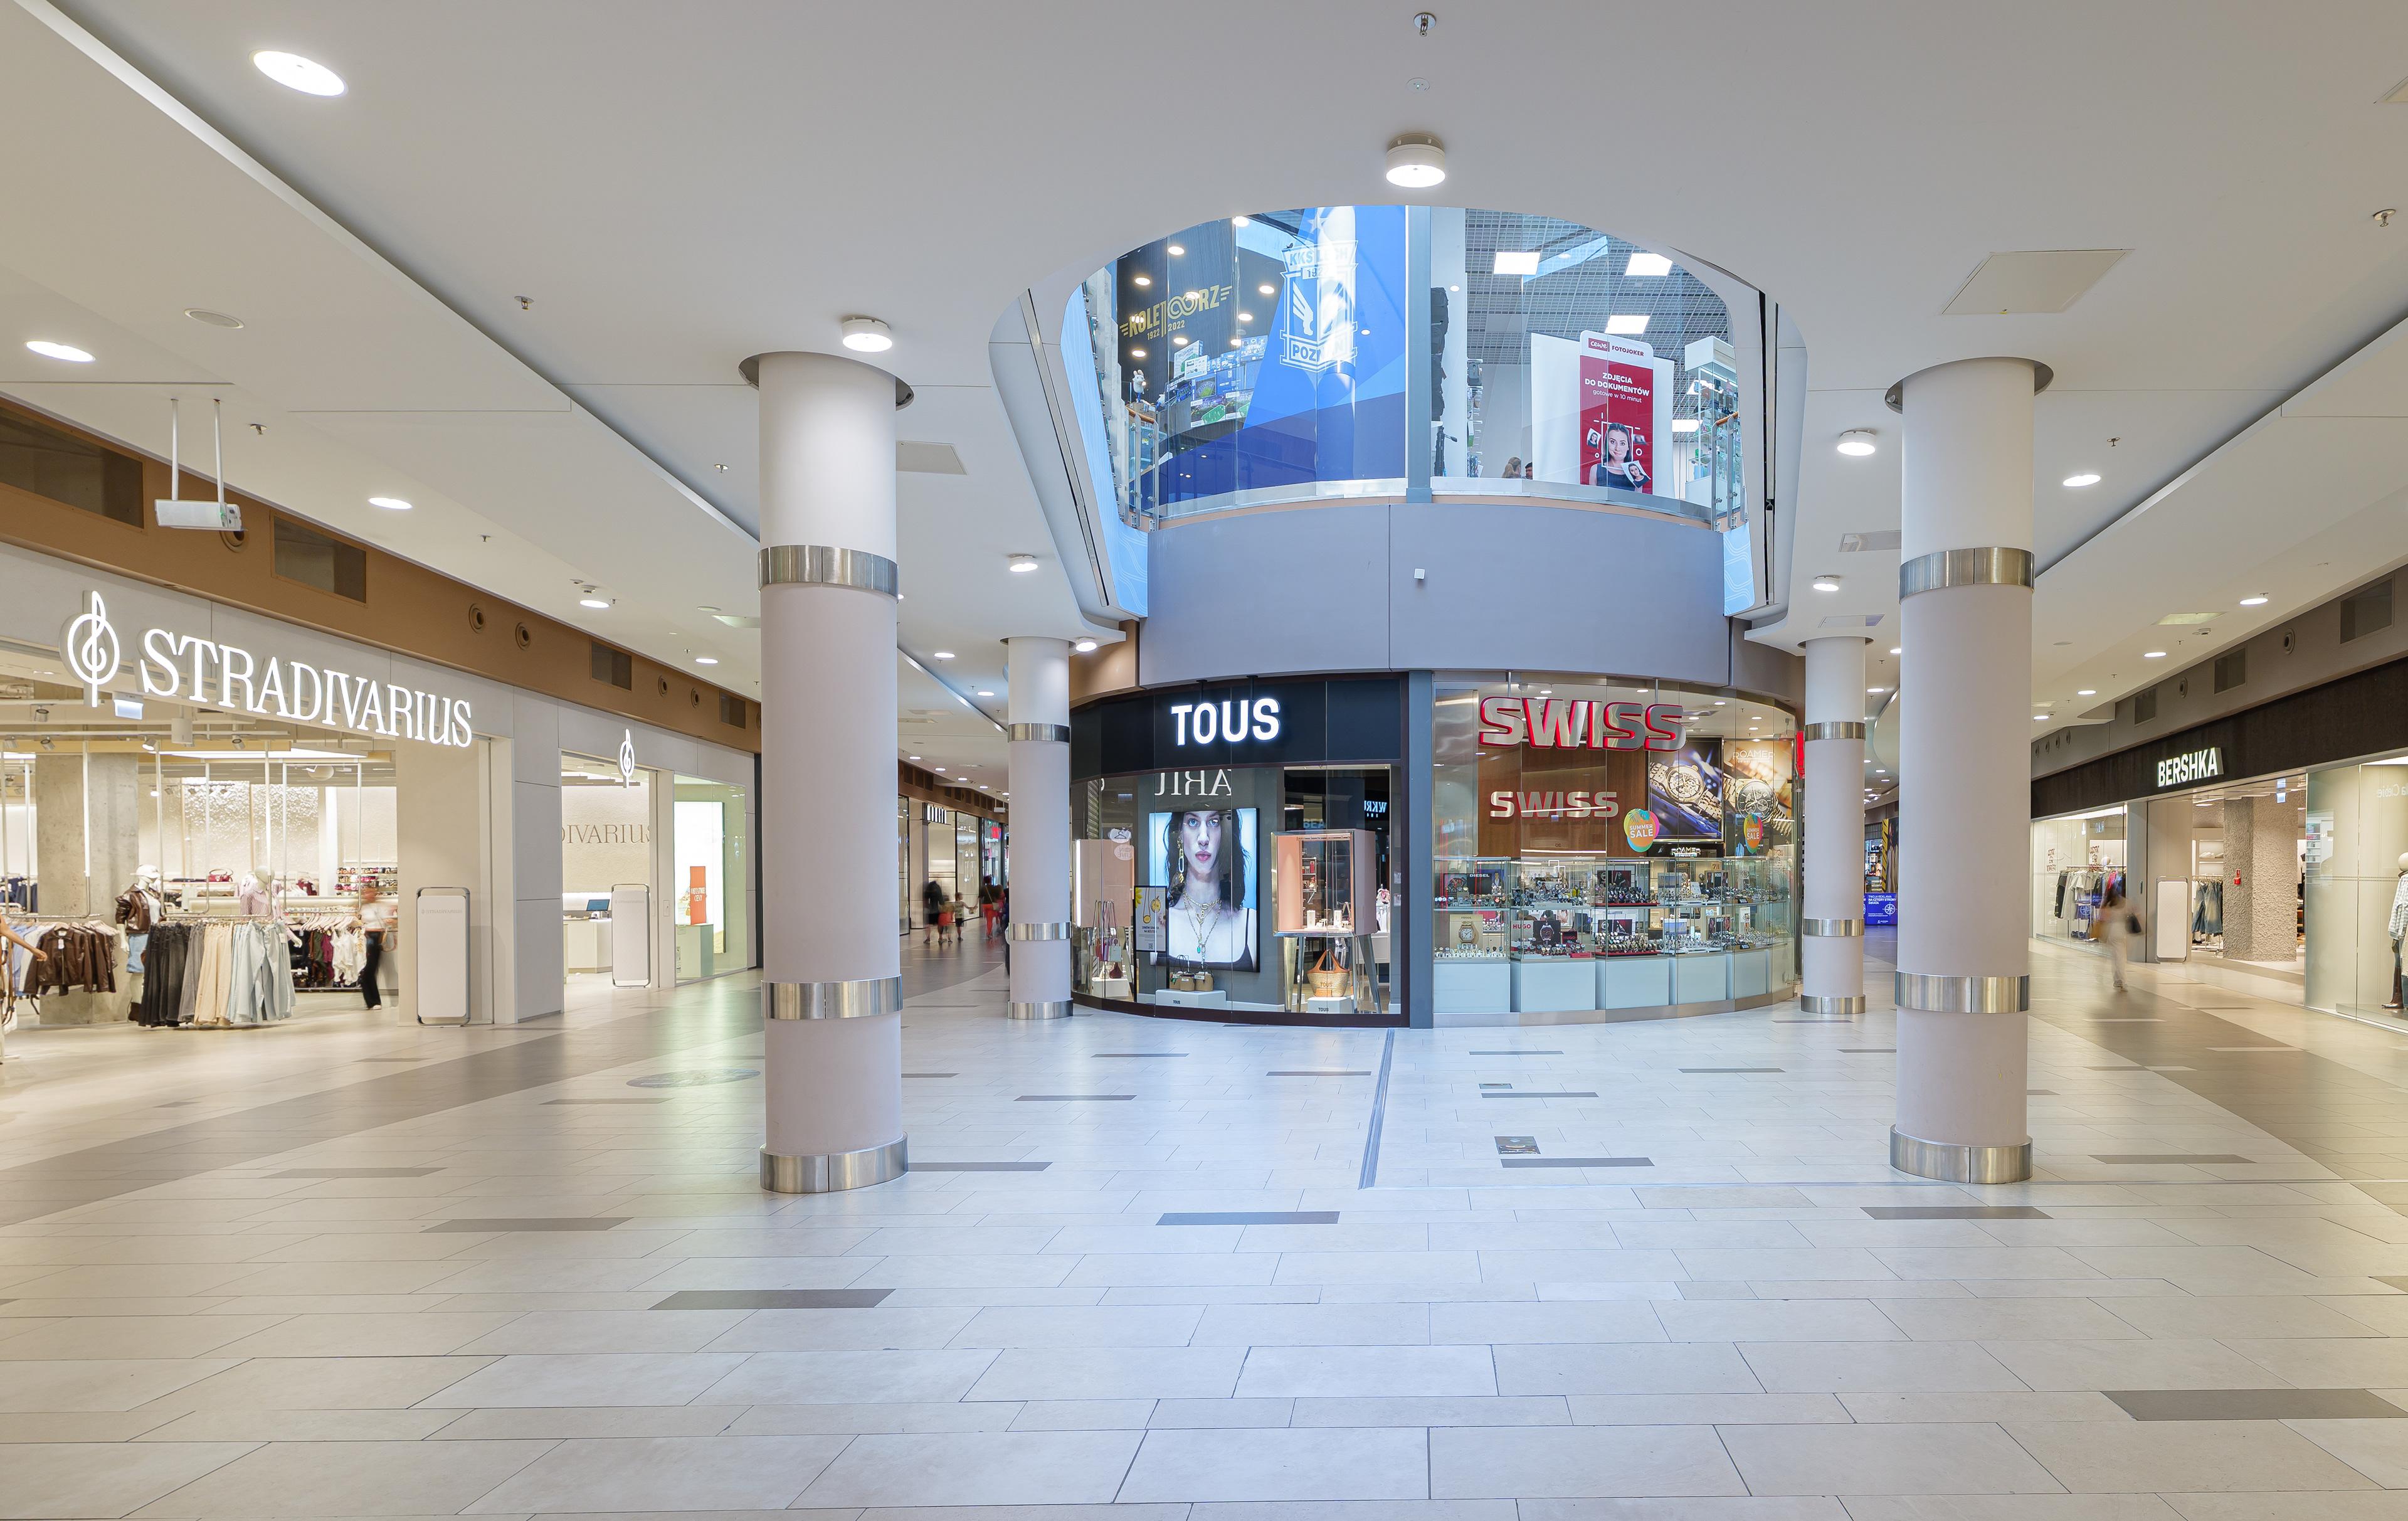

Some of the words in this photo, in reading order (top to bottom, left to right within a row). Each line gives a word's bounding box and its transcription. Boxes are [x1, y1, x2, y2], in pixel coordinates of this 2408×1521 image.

[1290, 250, 1313, 266] KKS
[1147, 328, 1160, 341] 1922
[1168, 320, 1185, 332] 2022
[1590, 341, 1608, 349] cewe
[1612, 346, 1644, 357] FOTOJOKER
[1585, 378, 1596, 386] DO
[1597, 381, 1650, 397] DOKUMENTÓW
[1602, 372, 1633, 384] ZDJĘCIA
[1593, 390, 1613, 398] gotowe
[140, 628, 472, 748] STRADIVARIUS
[1171, 697, 1281, 746] TOUS
[1479, 696, 1687, 752] SWISS
[1732, 750, 1774, 760] ROAMER
[2158, 747, 2219, 788] BERSHKA
[1490, 791, 1619, 819] SWISS
[1630, 829, 1654, 839] SALE
